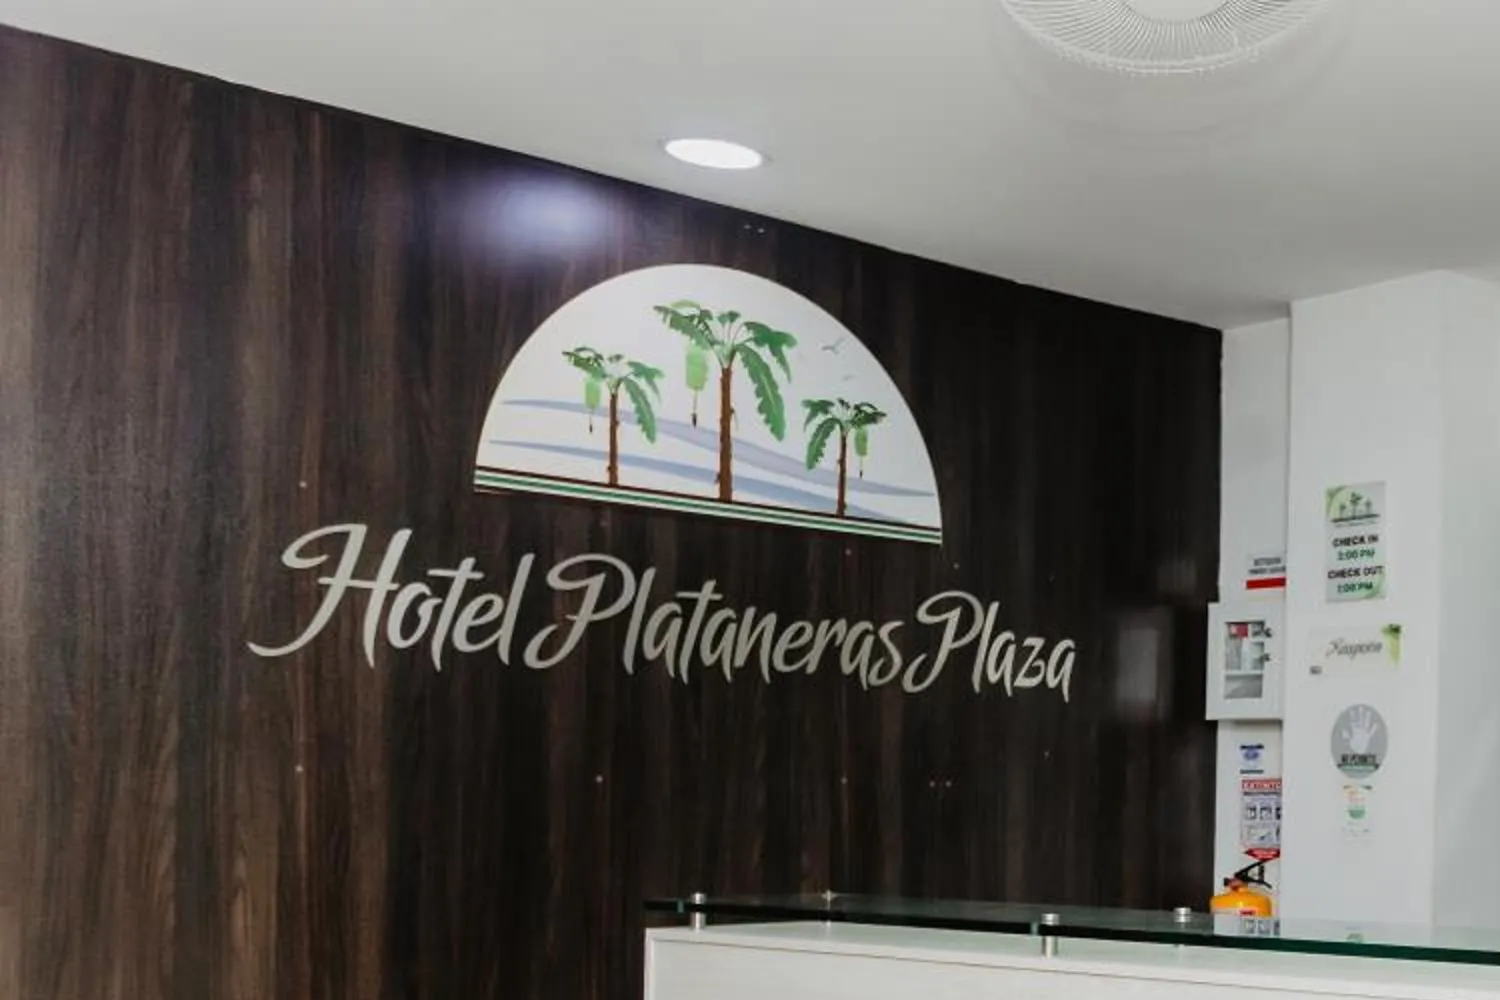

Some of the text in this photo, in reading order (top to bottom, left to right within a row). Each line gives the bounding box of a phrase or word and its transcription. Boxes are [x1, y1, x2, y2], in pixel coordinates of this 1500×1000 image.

[1332, 534, 1379, 548] CHECK IN
[1327, 565, 1384, 579] CHECK OUT
[247, 523, 1076, 702] Hotel Plataneras Plaza
